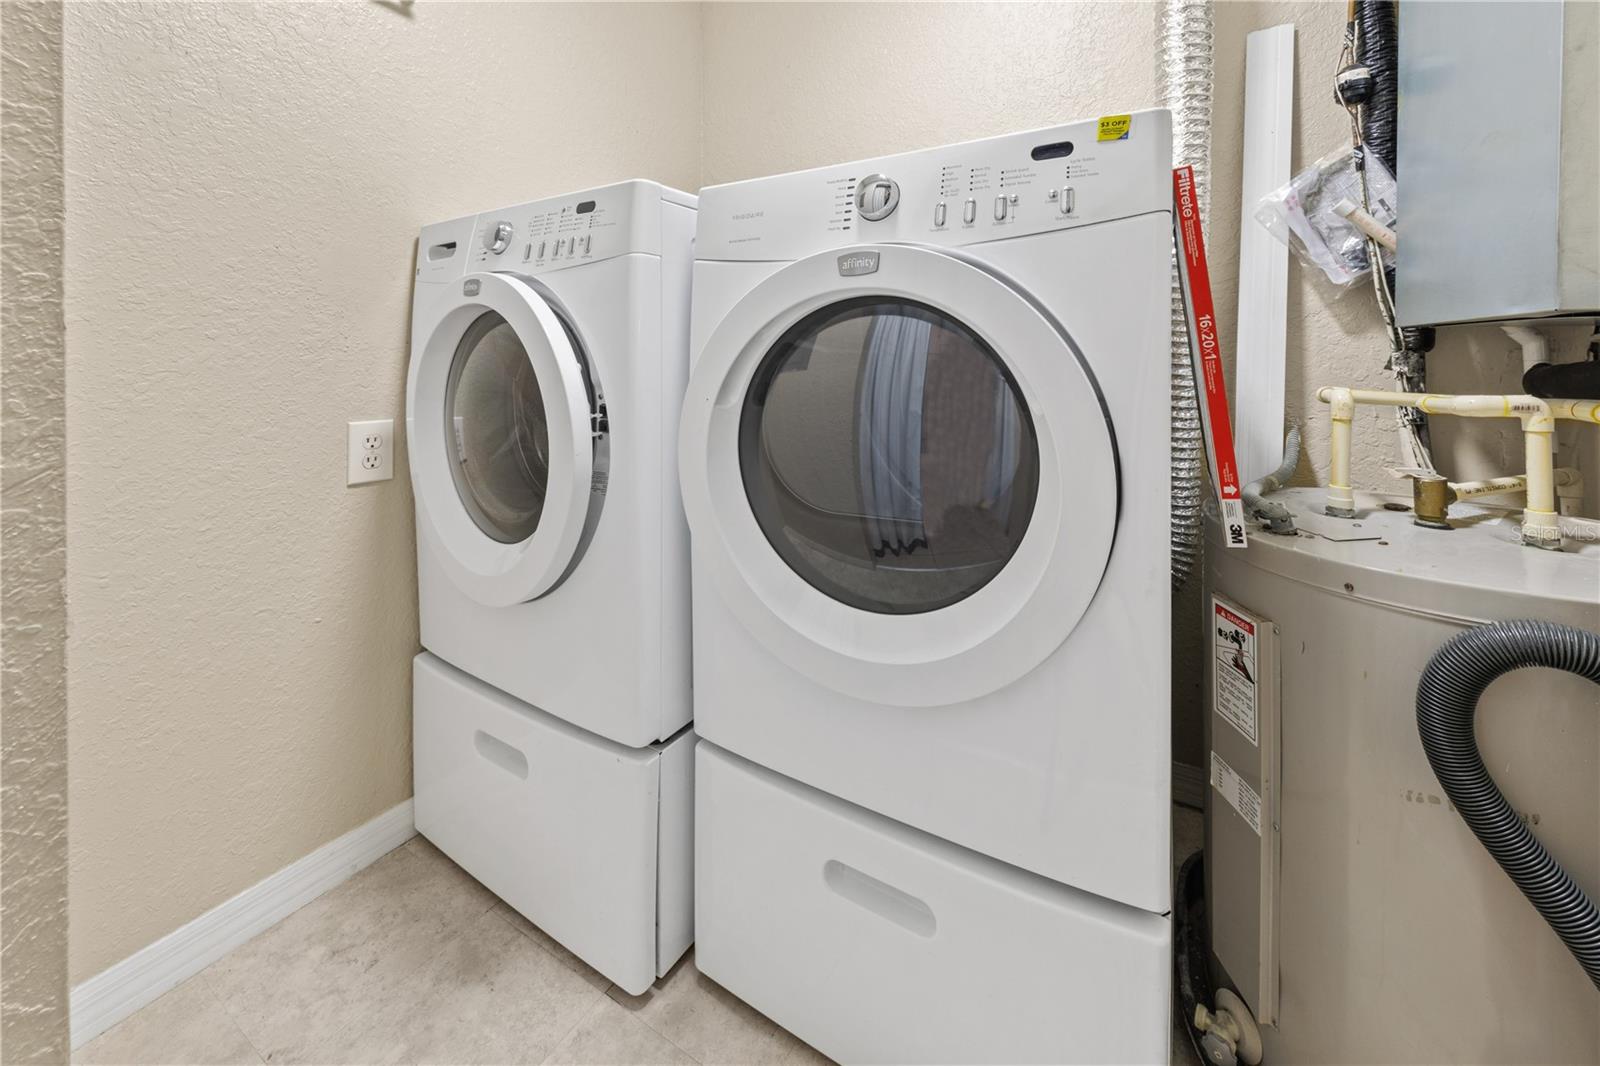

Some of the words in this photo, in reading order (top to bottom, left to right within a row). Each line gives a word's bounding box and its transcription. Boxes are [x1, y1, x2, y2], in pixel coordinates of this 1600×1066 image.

[1176, 168, 1194, 218] Filtrete
[841, 257, 875, 271] affinity
[1198, 314, 1217, 360] 16x20x1
[1229, 524, 1244, 544] 3M
